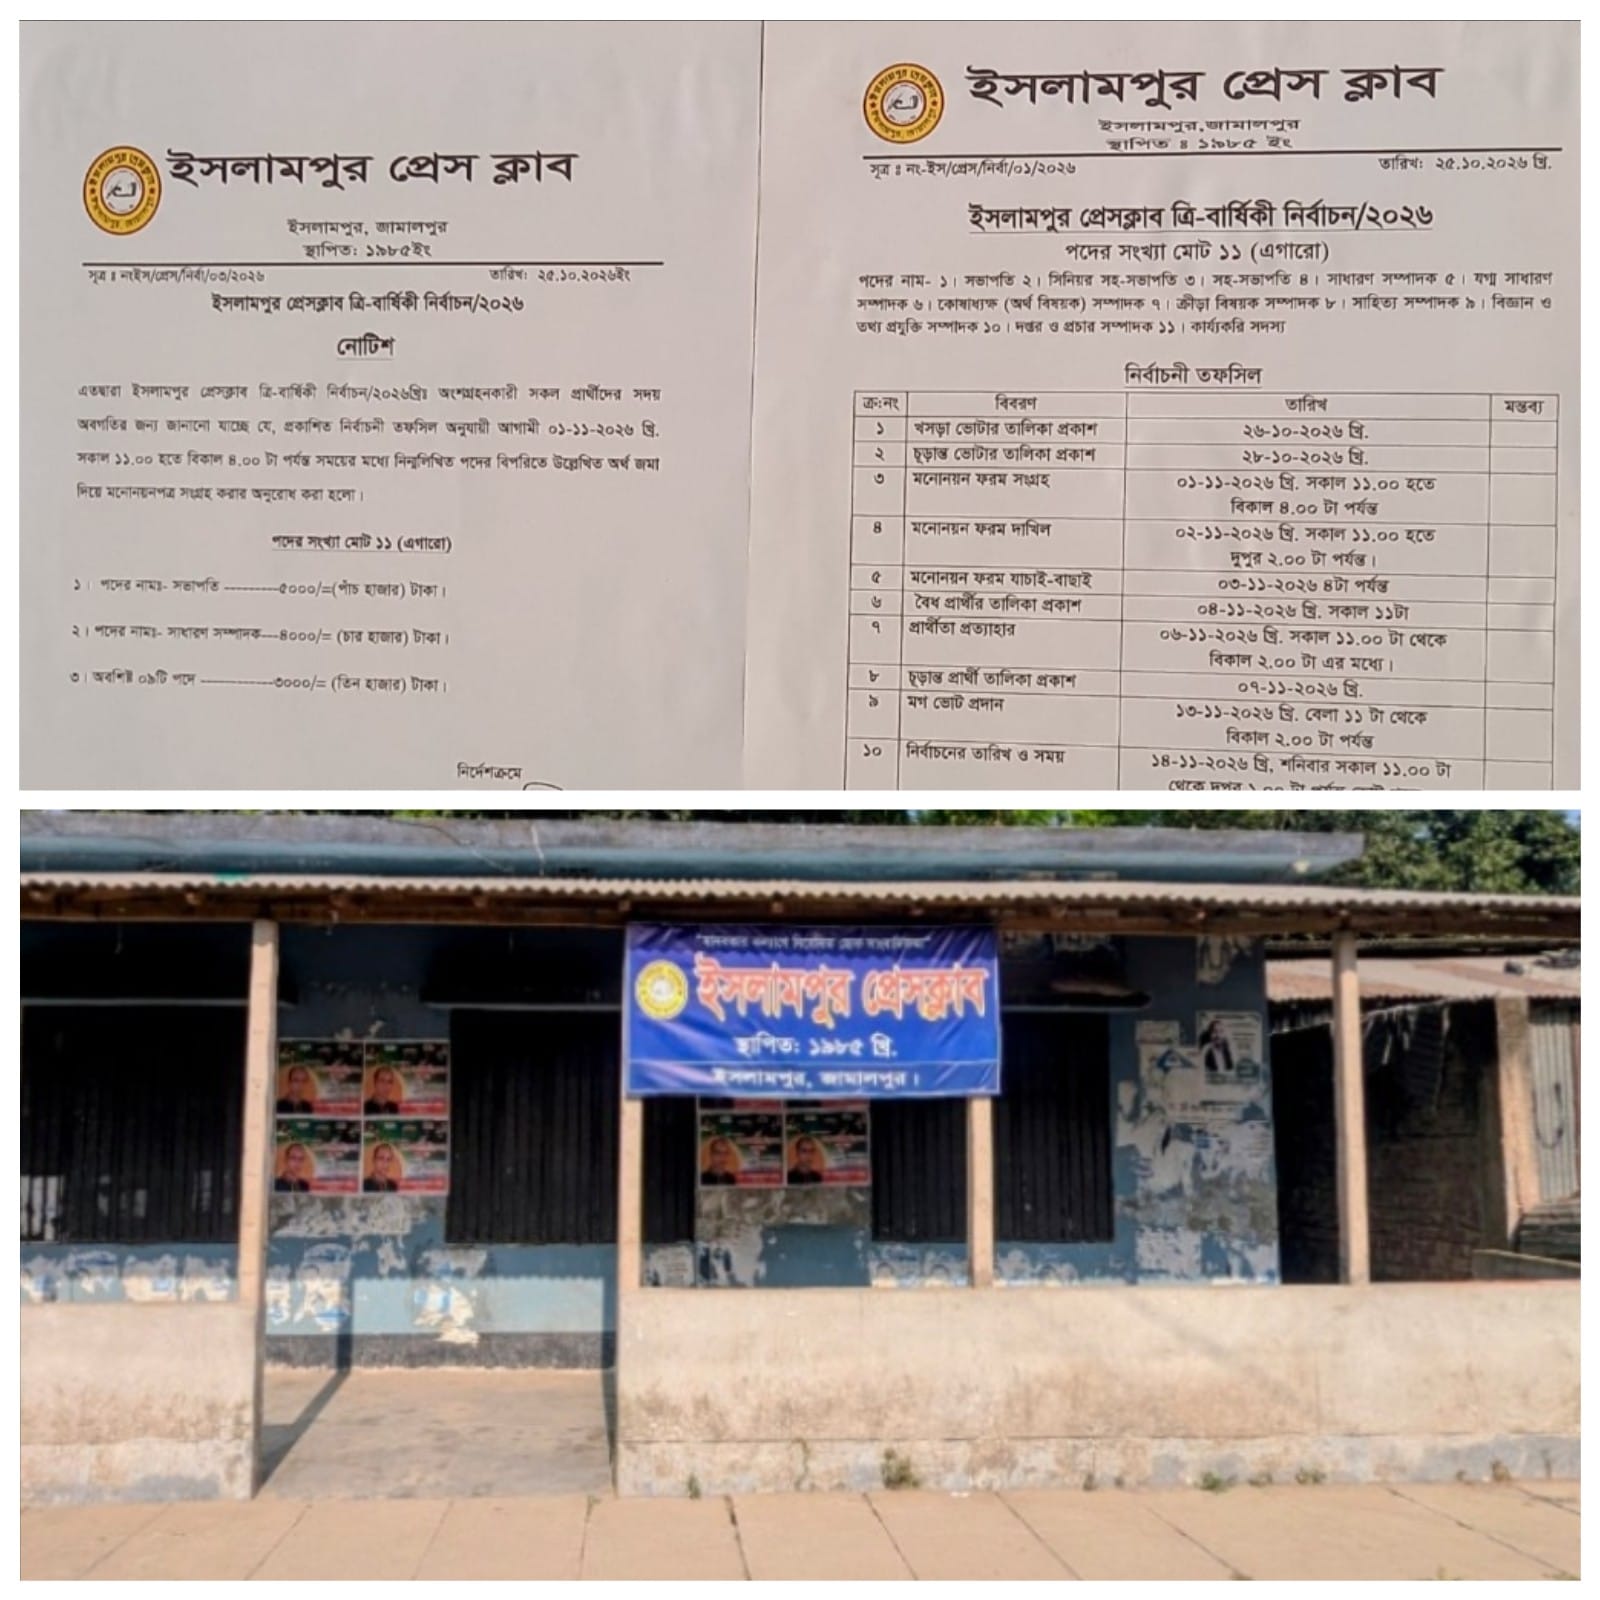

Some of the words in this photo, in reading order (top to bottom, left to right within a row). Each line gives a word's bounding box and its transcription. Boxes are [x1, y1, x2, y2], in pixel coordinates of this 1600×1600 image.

[965, 65, 1206, 110] ইসলামপুর
[1224, 67, 1329, 101] প্রেস
[1340, 64, 1445, 102] ক্লাব
[167, 149, 374, 190] ইসলামপুর
[390, 152, 480, 184] প্রেস
[490, 150, 579, 185] ক্লাব
[1378, 154, 1423, 170] তারিখ:
[1436, 157, 1528, 170] ২৫.১০.২০২৬
[968, 203, 1072, 231] ইসলামপুর
[1080, 206, 1165, 230] প্রেসক্লাব
[1171, 199, 1277, 227] ত্রি-বার্ষিকী
[1283, 199, 1433, 230] নির্বাচন/২০২৬
[287, 219, 368, 237] ইসলামপুর,
[376, 221, 448, 236] জামালপুর
[1065, 244, 1112, 260] পদের
[1118, 243, 1167, 262] সংখ্যা
[1173, 239, 1212, 260] মোট
[1220, 244, 1241, 260] ১১
[1251, 242, 1328, 264] (এগারো)
[212, 293, 282, 314] ইসলামপুর
[287, 296, 344, 312] প্রেসক্লাব
[349, 291, 419, 311] ত্রি-বার্ষিকী
[423, 291, 524, 313] নির্বাচন/২০২৬
[337, 332, 395, 356] নোটিশ
[1125, 363, 1189, 384] নির্বাচনী
[1196, 363, 1262, 384] তফসিল
[995, 395, 1037, 410] বিবরণ
[1285, 395, 1328, 412] তারিখ
[1504, 400, 1544, 414] মন্তব্য
[914, 422, 950, 437] খসড়া
[956, 420, 999, 435] ভোটার
[1005, 420, 1053, 435] তালিকা
[1058, 423, 1097, 436] প্রকাশ
[1243, 424, 1343, 440] ২৬-১০-২০২৬
[914, 448, 948, 464] চূড়ান্ত
[954, 446, 998, 460] ভোটার
[1003, 446, 1051, 461] তালিকা
[1056, 448, 1096, 461] প্রকাশ
[1243, 450, 1343, 465] ২৮-১০-২০২৬
[913, 473, 971, 485] মনোনয়ন
[976, 473, 1007, 485] ফরম
[1013, 474, 1050, 488] সংগ্রহ
[1177, 476, 1273, 490] ০১-১১-২০২৬
[1306, 476, 1346, 490] সকাল
[1353, 477, 1399, 491] ১১.০০
[1405, 478, 1437, 492] হতে
[1230, 497, 1274, 514] বিকাল
[1280, 501, 1317, 515] ৪.০০
[1323, 498, 1338, 515] টা
[1344, 498, 1379, 515] পর্যন্ত
[911, 522, 969, 535] মনোনয়ন
[974, 523, 1006, 535] ফরম
[1011, 519, 1051, 536] দাখিল
[1176, 526, 1273, 541] ০২-১১-২০২৬
[1305, 528, 1346, 541] সকাল
[1352, 529, 1398, 542] ১১.০০
[1405, 529, 1436, 544] হতে
[1230, 552, 1262, 568] দুপুর
[1268, 553, 1305, 566] ২.০০
[1311, 550, 1327, 565] টা
[1332, 550, 1375, 566] পর্যন্ত।
[910, 571, 969, 584] মনোনয়ন
[973, 573, 1005, 584] ফরম
[1010, 571, 1092, 588] যাচাই-বাছাই
[1218, 578, 1317, 593] ০৩-১১-২০২৬
[1323, 576, 1349, 592] ৪টা
[1355, 576, 1390, 593] পর্যন্ত
[915, 593, 939, 609] বৈধ
[945, 593, 983, 609] প্রার্থীর
[989, 595, 1037, 611] তালিকা
[1042, 599, 1081, 612] প্রকাশ
[1198, 603, 1296, 619] ০৪-১১-২০২৬
[1328, 605, 1369, 618] সকাল
[1376, 604, 1409, 620] ১১টা
[960, 617, 1016, 637] প্রত্যাহার
[1160, 628, 1257, 644] ০৬-১১-২০২৬
[1289, 630, 1331, 644] সকাল
[1337, 632, 1382, 645] ১১.০০
[1388, 629, 1404, 646] টা
[1408, 628, 1447, 647] থেকে
[1209, 649, 1252, 667] বিকাল
[1258, 655, 1295, 669] ২.০০
[1301, 653, 1317, 669] টা
[1322, 657, 1345, 669] এর
[909, 671, 943, 687] চূড়ান্ত
[948, 670, 978, 684] প্রার্থী
[984, 671, 1032, 686] তালিকা
[1037, 674, 1076, 687] প্রকাশ
[1238, 681, 1337, 697] ০৭-১১-২০২৬
[934, 695, 964, 709] ভোট
[968, 698, 1004, 711] প্রদান
[1177, 704, 1273, 721] ১৩-১১-২০২৬
[1306, 708, 1339, 722] বেলা
[1345, 710, 1362, 723] ১১
[1390, 705, 1429, 724] থেকে
[1226, 726, 1270, 745] বিকাল
[1275, 733, 1312, 747] ২.০০
[1339, 731, 1374, 749] পর্যন্ত
[906, 741, 966, 759] নির্বাচনের
[971, 744, 1012, 761] তারিখ
[1034, 745, 1066, 763] সময়
[1152, 754, 1248, 771] ১৪-১১-২০২৬
[1280, 755, 1330, 772] শনিবার
[1335, 761, 1377, 774] সকাল
[1384, 762, 1429, 776] ১১.০০
[694, 953, 856, 1030] ইসলামপুর
[863, 962, 990, 1020] প্রেসক্লাব
[735, 1031, 800, 1055] স্থাপিত:
[809, 1037, 862, 1056] ১৯৮৫
